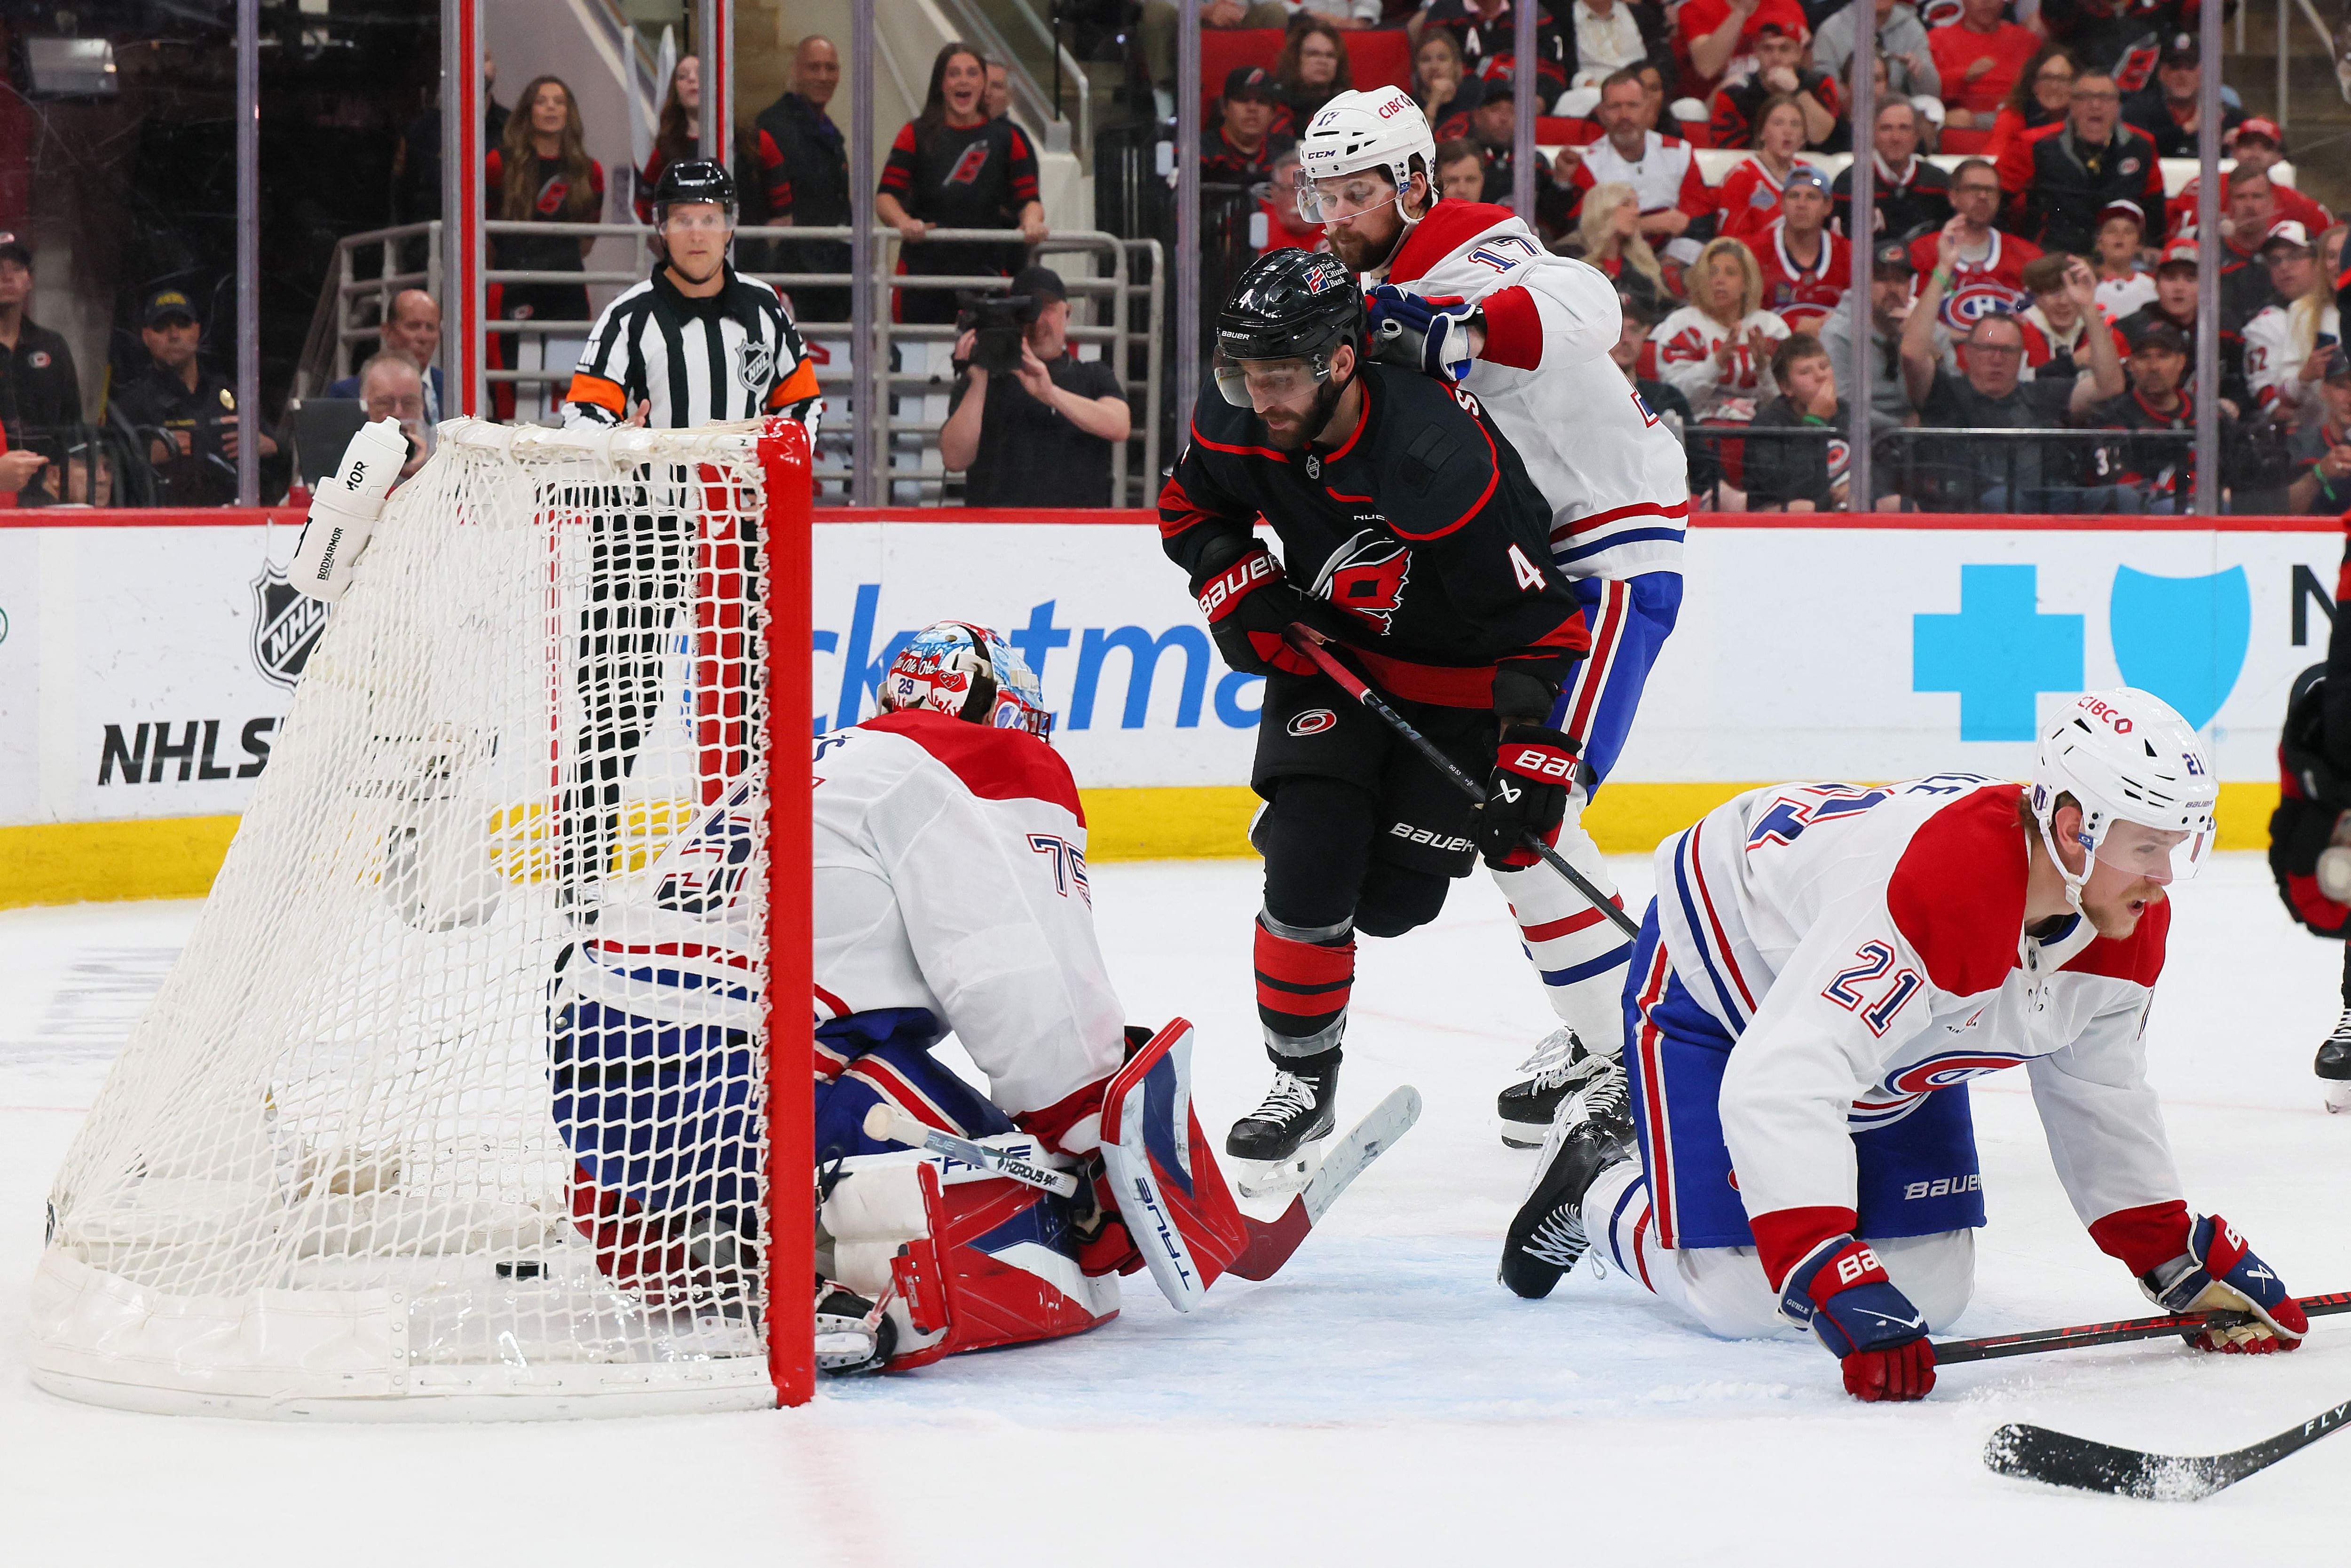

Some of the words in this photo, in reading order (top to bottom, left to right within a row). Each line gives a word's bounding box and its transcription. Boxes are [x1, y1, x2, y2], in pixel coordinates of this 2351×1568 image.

[1378, 97, 1404, 119] CIBC
[1308, 150, 1336, 159] CCM
[1320, 261, 1336, 270] First
[1467, 236, 1543, 274] 17
[1329, 276, 1346, 287] Bank
[1238, 288, 1255, 310] 4
[1222, 330, 1250, 340] BAUER
[317, 527, 344, 581] BODYARMOR
[1507, 542, 1546, 592] 4
[269, 595, 323, 664] NHL
[898, 678, 914, 695] 29
[2182, 753, 2205, 776] 21
[1821, 939, 1925, 1039] 21
[1135, 1177, 1190, 1292] TRUE
[1786, 1299, 1809, 1315] GUHLE
